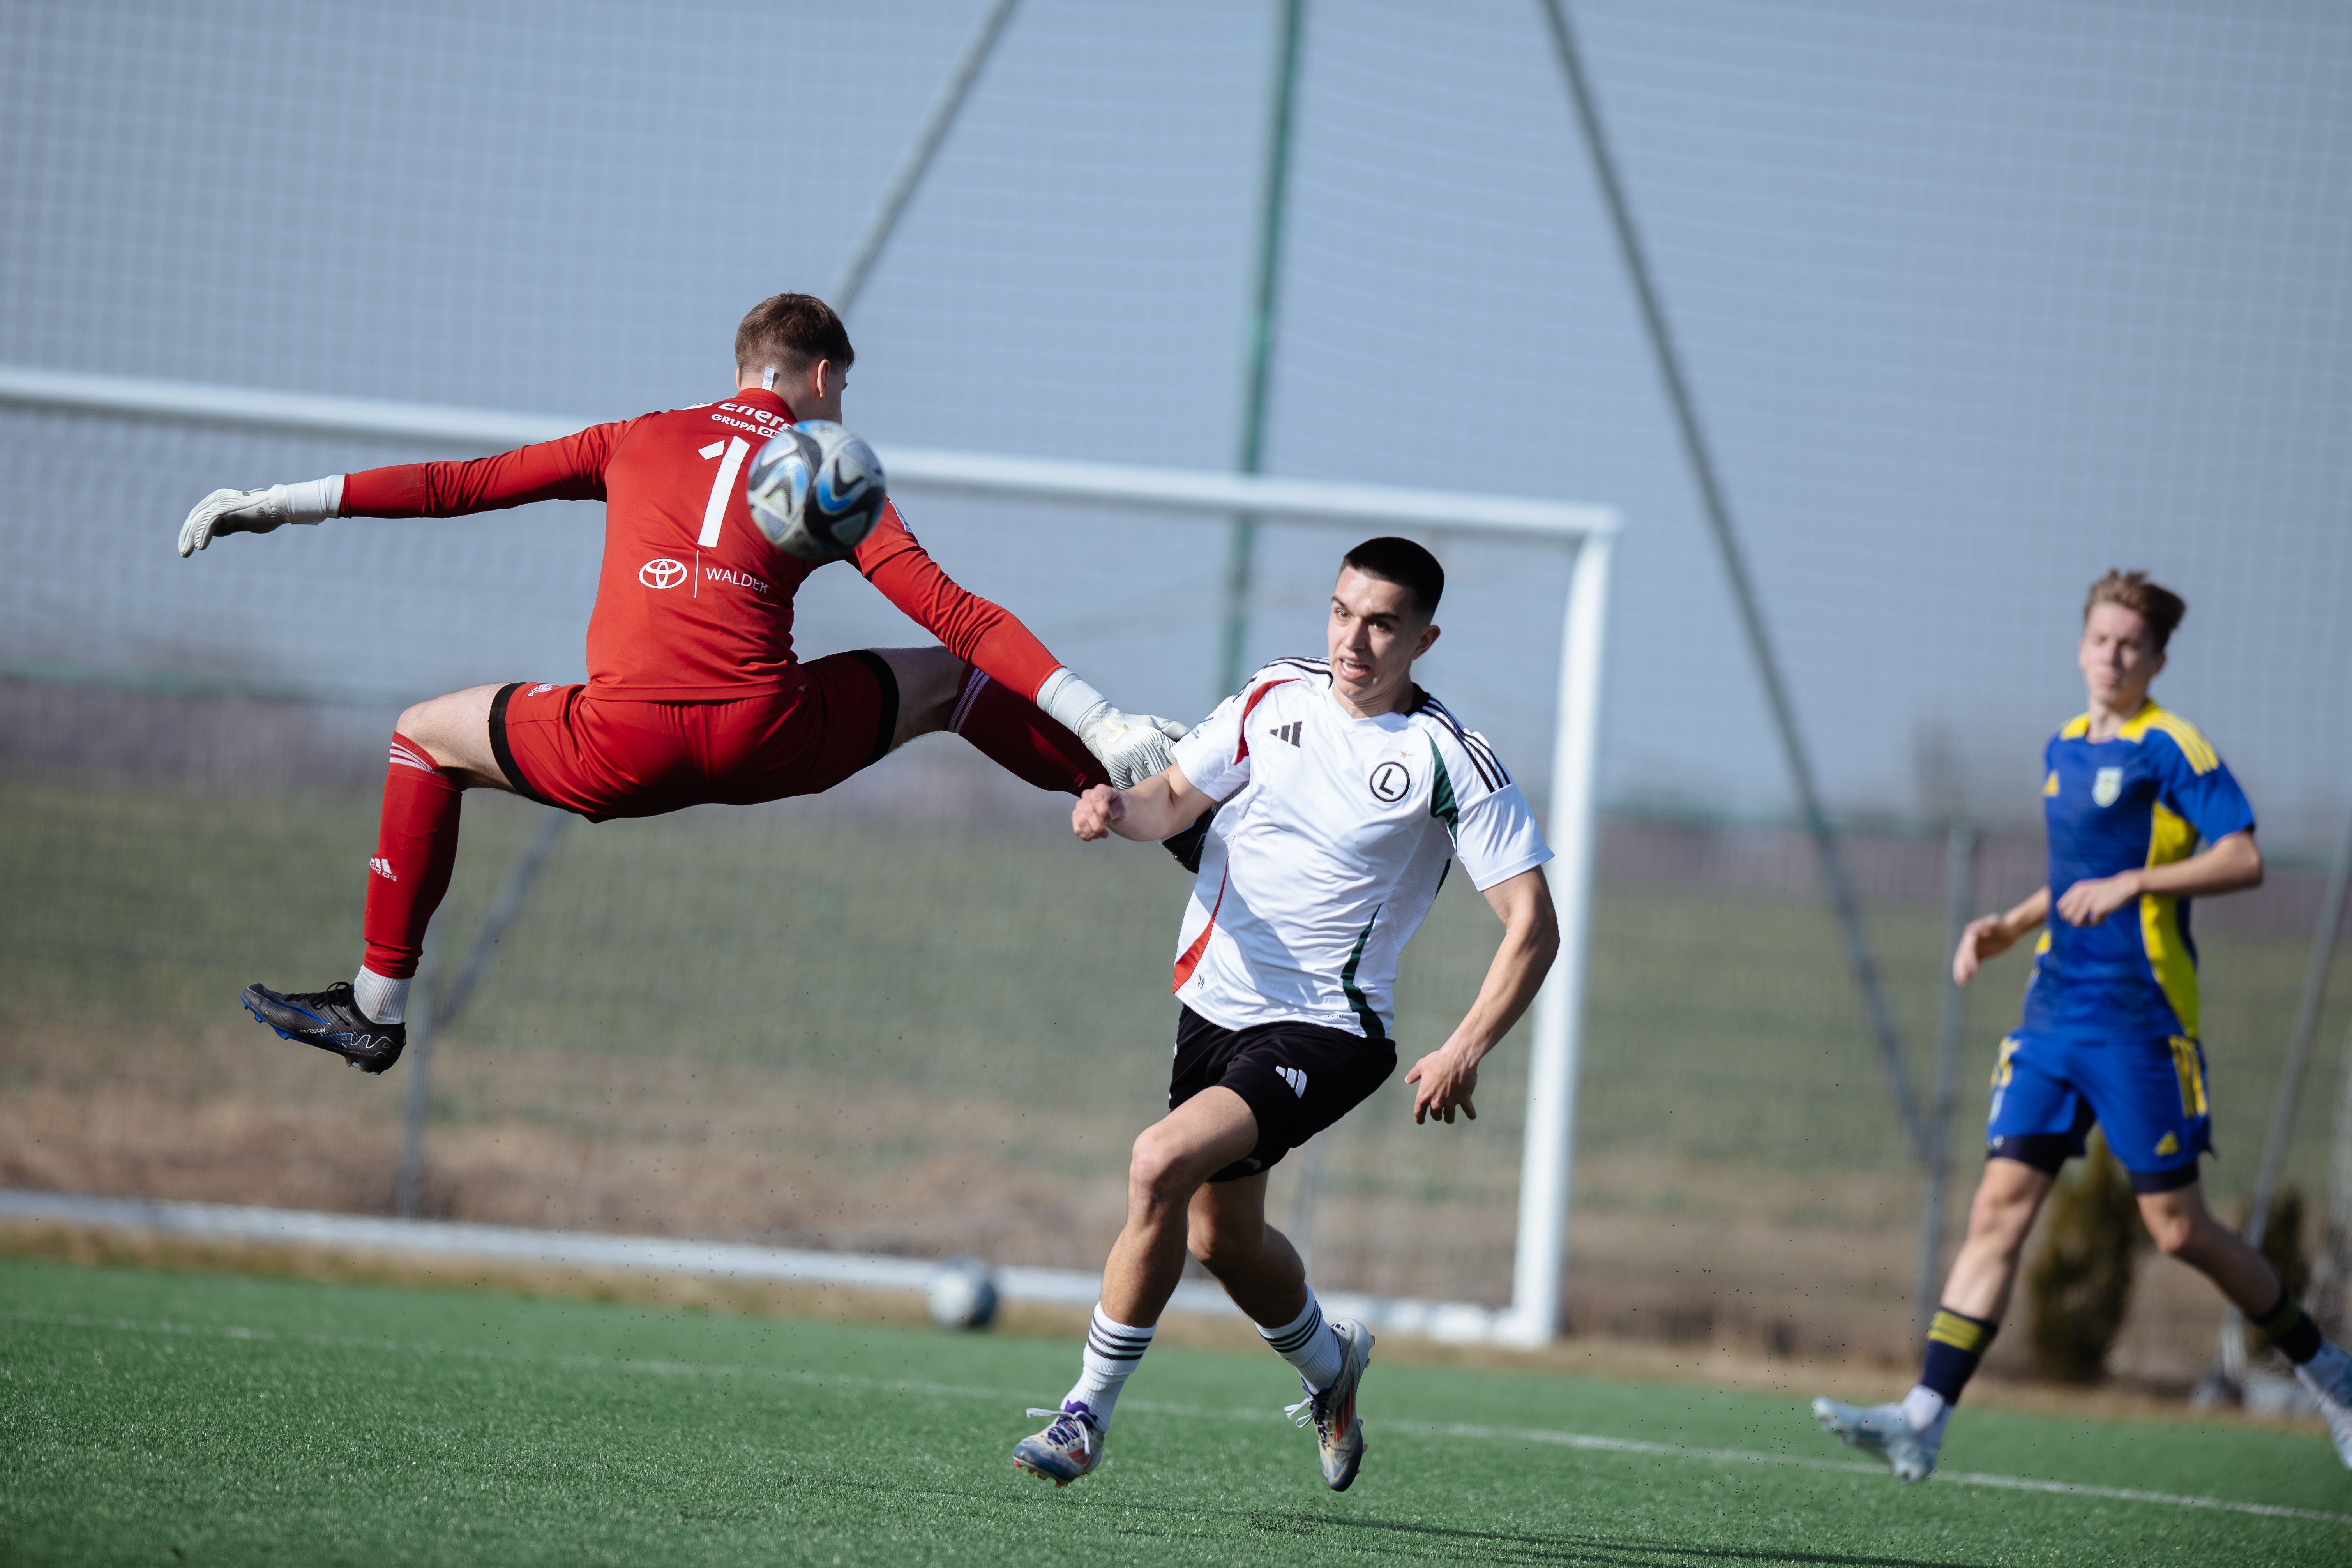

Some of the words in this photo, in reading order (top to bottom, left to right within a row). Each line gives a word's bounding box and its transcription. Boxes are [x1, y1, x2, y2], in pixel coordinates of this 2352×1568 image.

[711, 414, 756, 433] GRUPA
[697, 435, 751, 548] 1
[706, 567, 768, 594] WALDER
